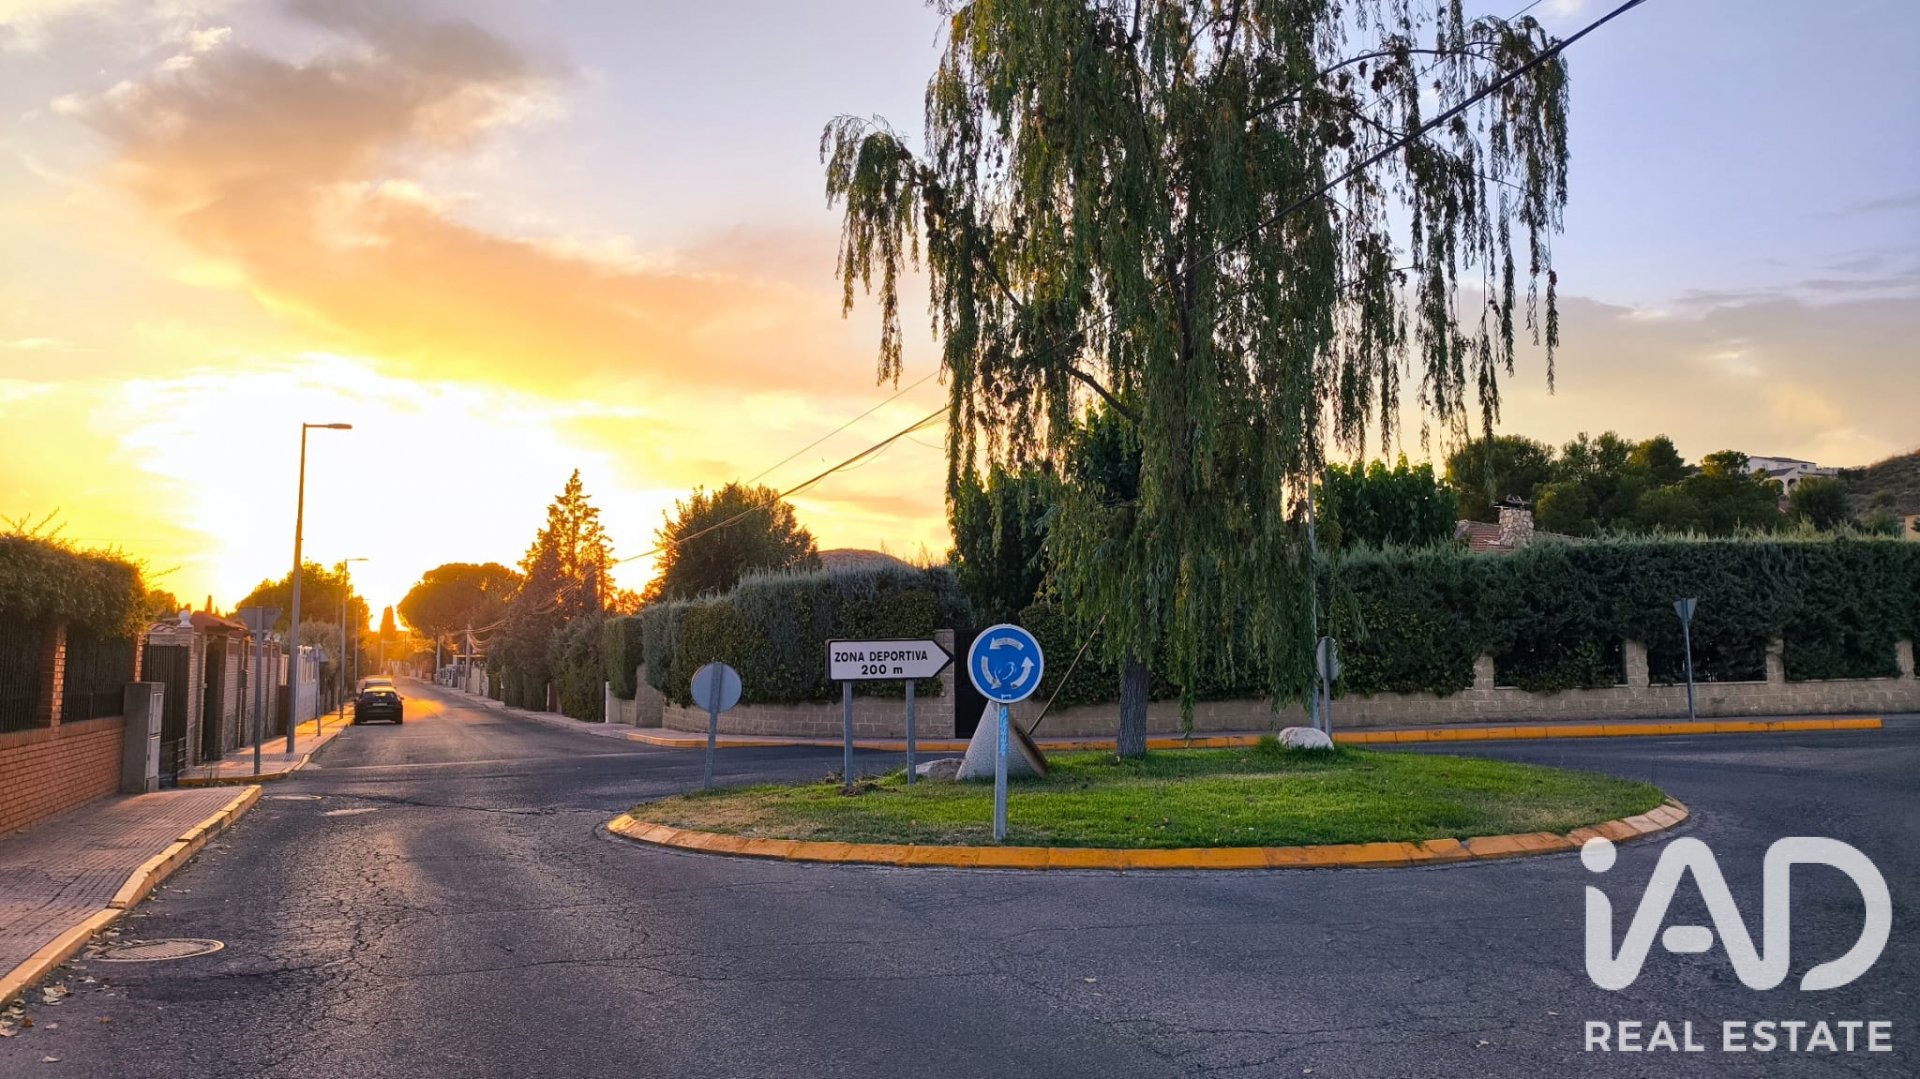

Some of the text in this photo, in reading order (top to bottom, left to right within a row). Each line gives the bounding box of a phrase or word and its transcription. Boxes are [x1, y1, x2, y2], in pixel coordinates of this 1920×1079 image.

[834, 650, 928, 663] ZONA DEPORTIVA
[861, 664, 904, 676] 200 m
